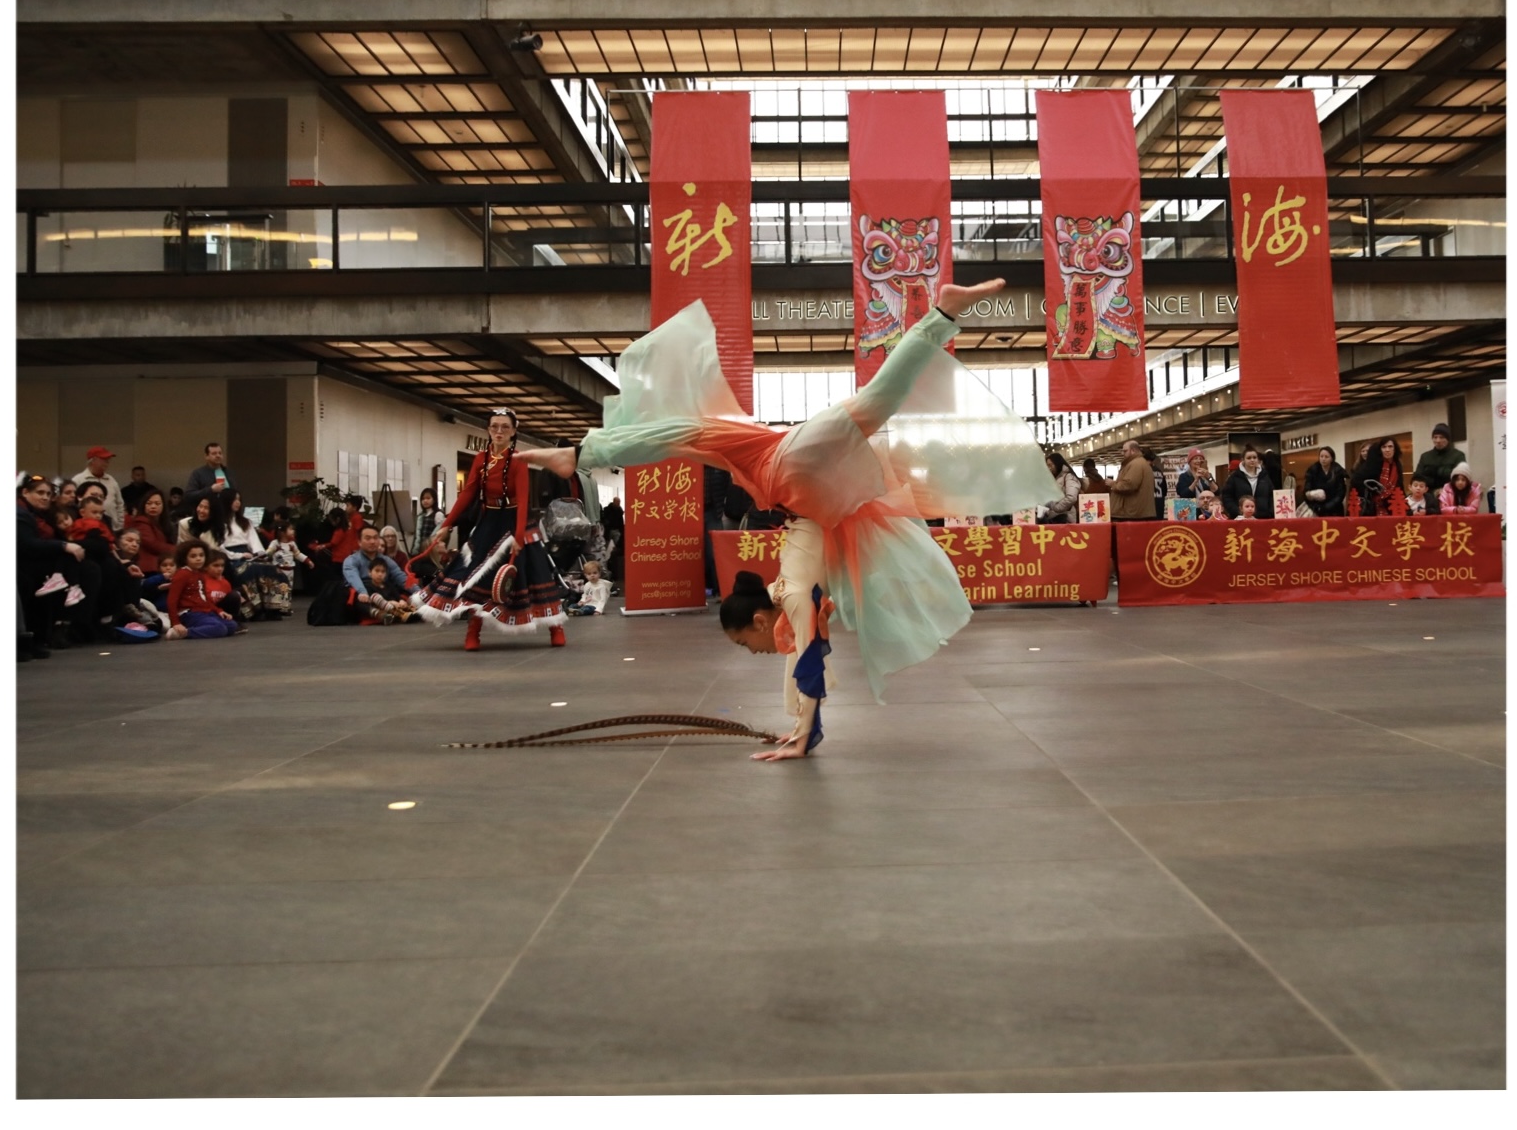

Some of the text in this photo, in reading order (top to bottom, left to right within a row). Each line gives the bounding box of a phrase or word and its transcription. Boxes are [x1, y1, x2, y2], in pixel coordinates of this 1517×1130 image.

[775, 300, 854, 321] THEATE
[1066, 282, 1089, 353] 萬事勝意
[632, 534, 699, 549] Jersey Shore
[1222, 520, 1476, 563] 新海中文學校
[630, 549, 702, 563] Chinese School
[983, 558, 1042, 578] School
[1228, 566, 1477, 588] JERSEY SHORE CHINESE SCHOOL
[1004, 580, 1081, 601] Learning
